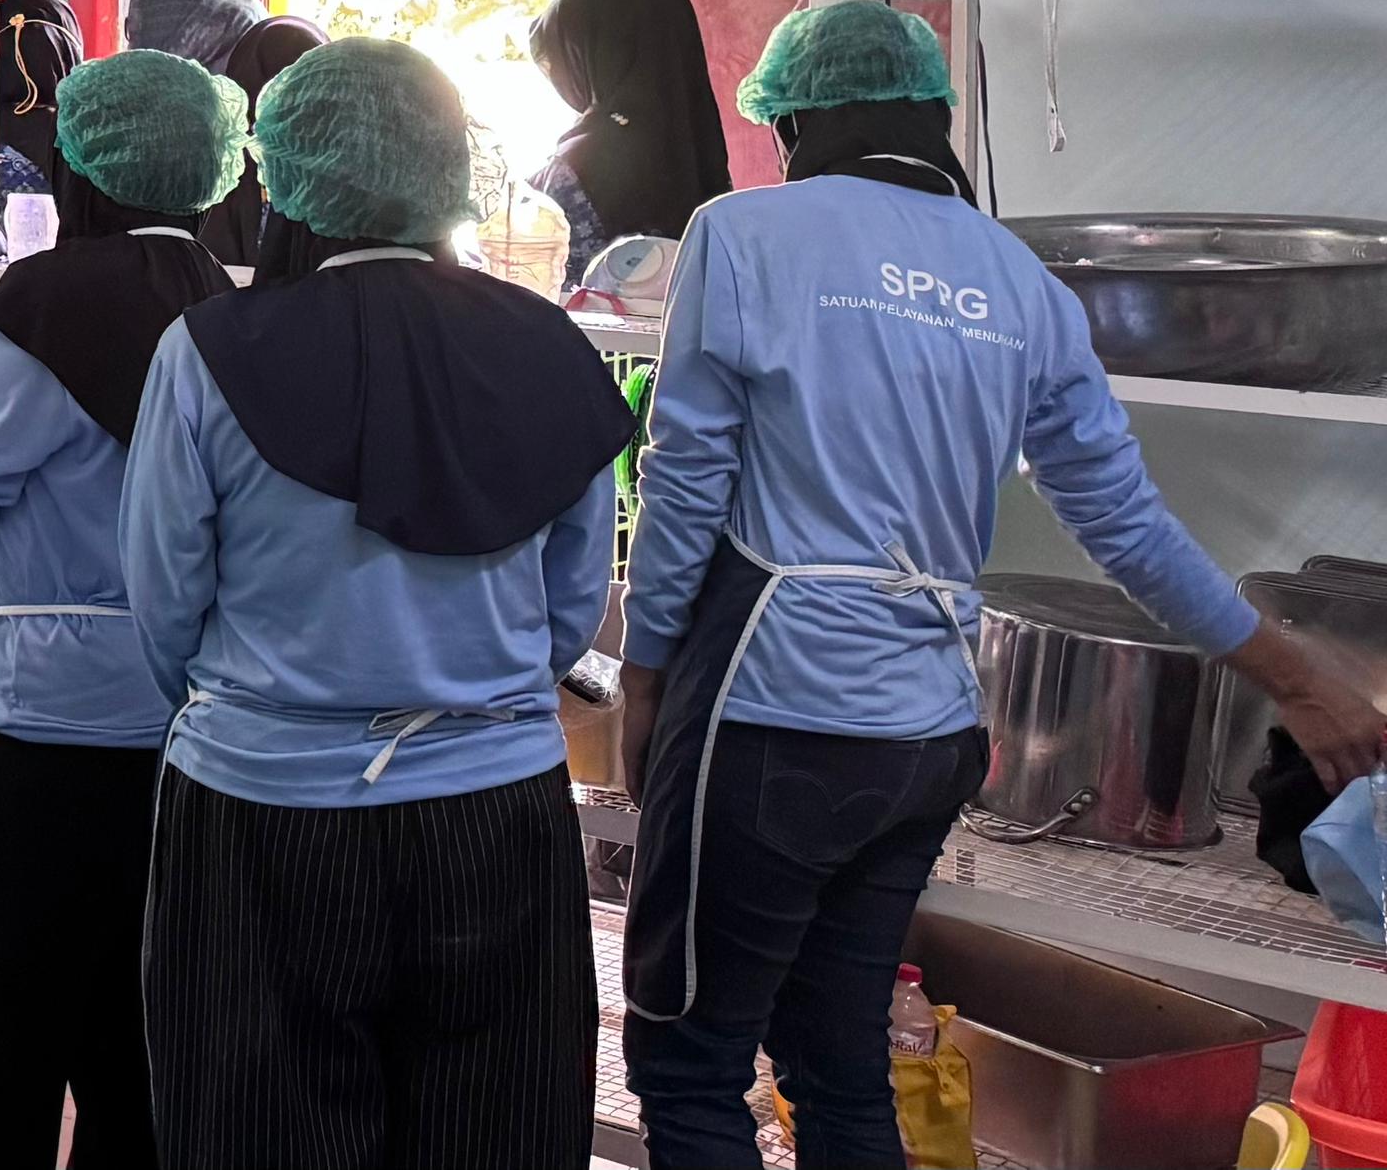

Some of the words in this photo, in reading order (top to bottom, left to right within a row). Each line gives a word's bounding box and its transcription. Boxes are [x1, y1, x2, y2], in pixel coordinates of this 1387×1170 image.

[819, 295, 878, 310] SATUAN
[878, 301, 954, 328] PELAYANAN
[880, 262, 988, 320] SPPG
